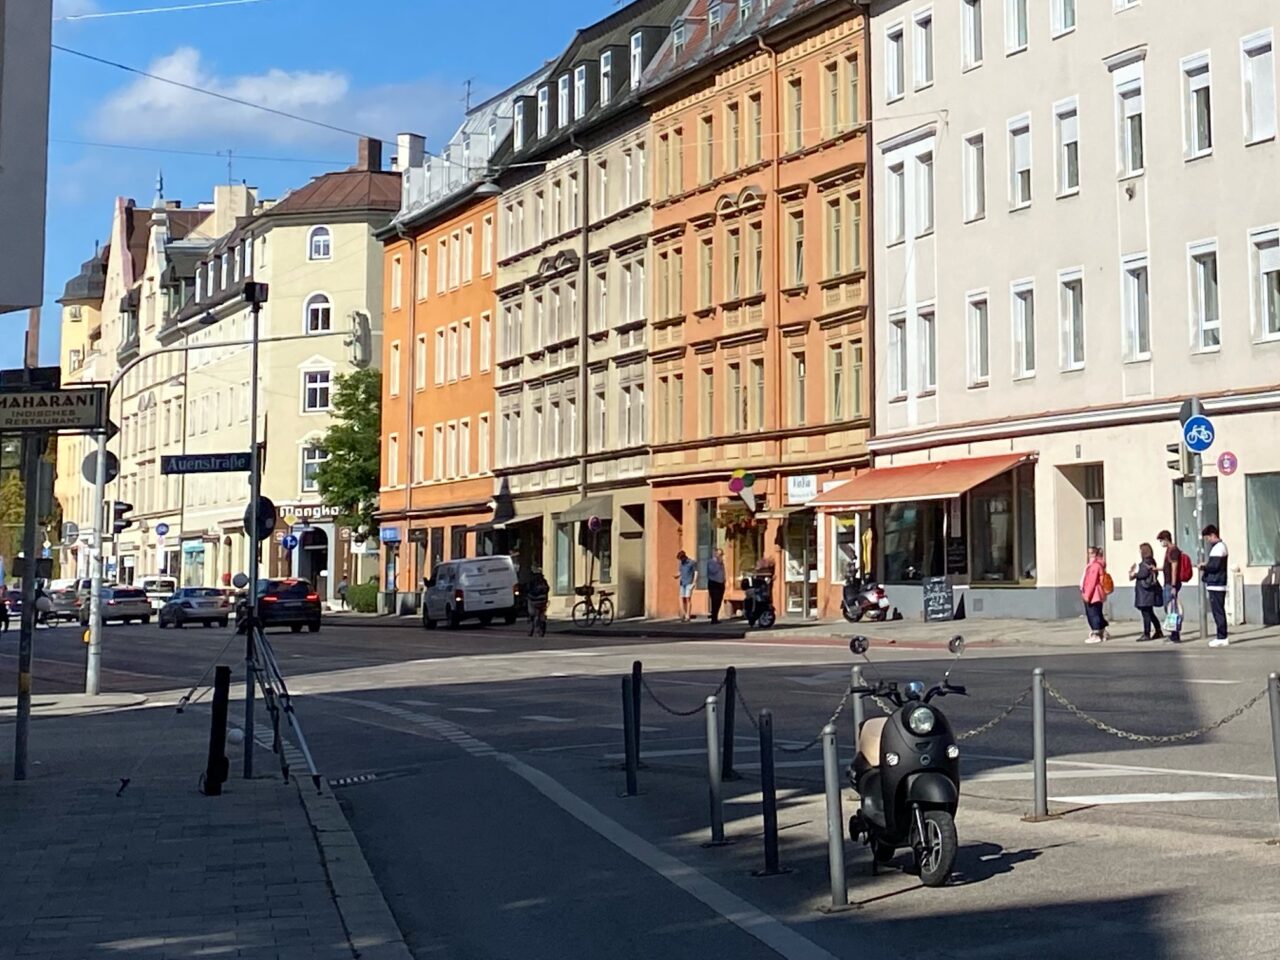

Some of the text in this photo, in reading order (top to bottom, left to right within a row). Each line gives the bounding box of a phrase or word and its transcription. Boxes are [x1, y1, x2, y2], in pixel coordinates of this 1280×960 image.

[11, 408, 77, 418] INDISCHES
[4, 416, 83, 426] RESTAURANT
[167, 454, 246, 472] Auenstraße
